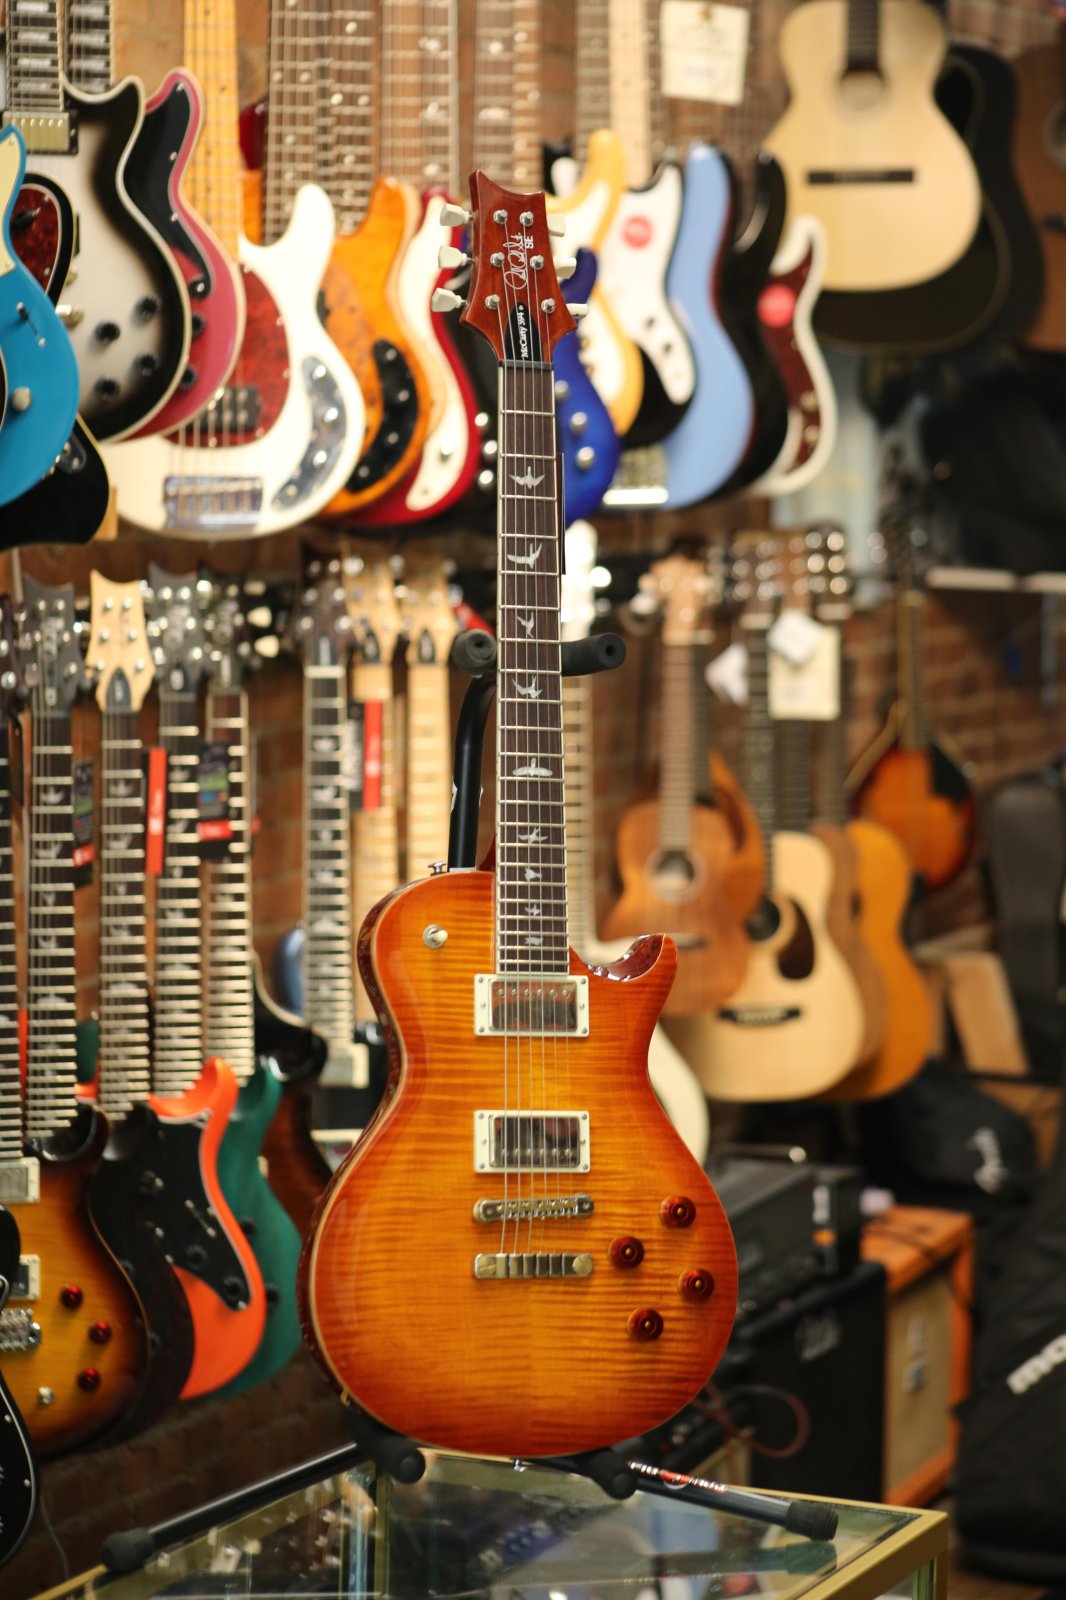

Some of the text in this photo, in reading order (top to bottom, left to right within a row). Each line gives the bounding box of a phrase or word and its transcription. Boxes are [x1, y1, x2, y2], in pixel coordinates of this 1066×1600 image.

[525, 235, 534, 250] SE
[517, 311, 529, 358] McCarty 594
